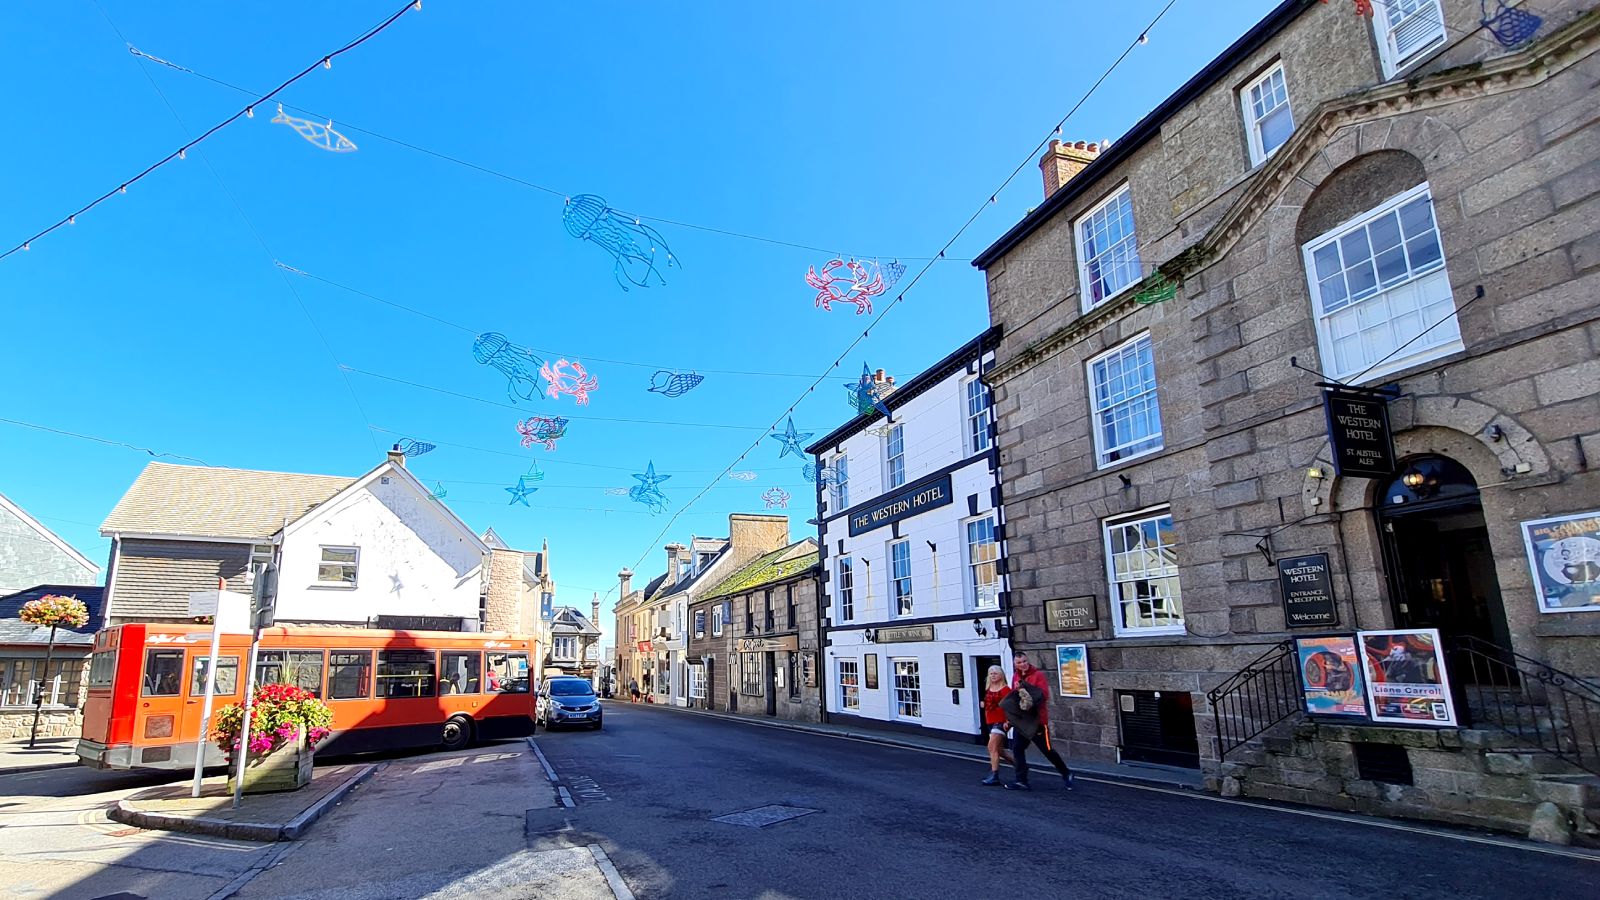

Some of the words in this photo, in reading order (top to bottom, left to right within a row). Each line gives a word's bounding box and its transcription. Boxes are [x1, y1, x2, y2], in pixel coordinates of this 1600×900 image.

[1347, 403, 1367, 415] THE
[1337, 415, 1381, 429] WESTERN
[1346, 428, 1377, 441] HOTEL
[1356, 449, 1382, 458] AUSTELL
[1359, 458, 1375, 466] ALES
[853, 514, 869, 529] THE
[871, 498, 910, 522] WESTERN
[912, 486, 944, 507] HOTEL
[1283, 565, 1324, 575] WESTERN
[1290, 574, 1319, 584] HOTEL
[1290, 589, 1324, 598] ENTRANCE
[1294, 595, 1329, 603] RECEPTION
[1052, 607, 1089, 618] WESTERN
[1292, 612, 1330, 620] Welcome
[1057, 618, 1084, 628] HOTEL
[1374, 686, 1402, 694] Liane
[1404, 686, 1442, 695] Carroll
